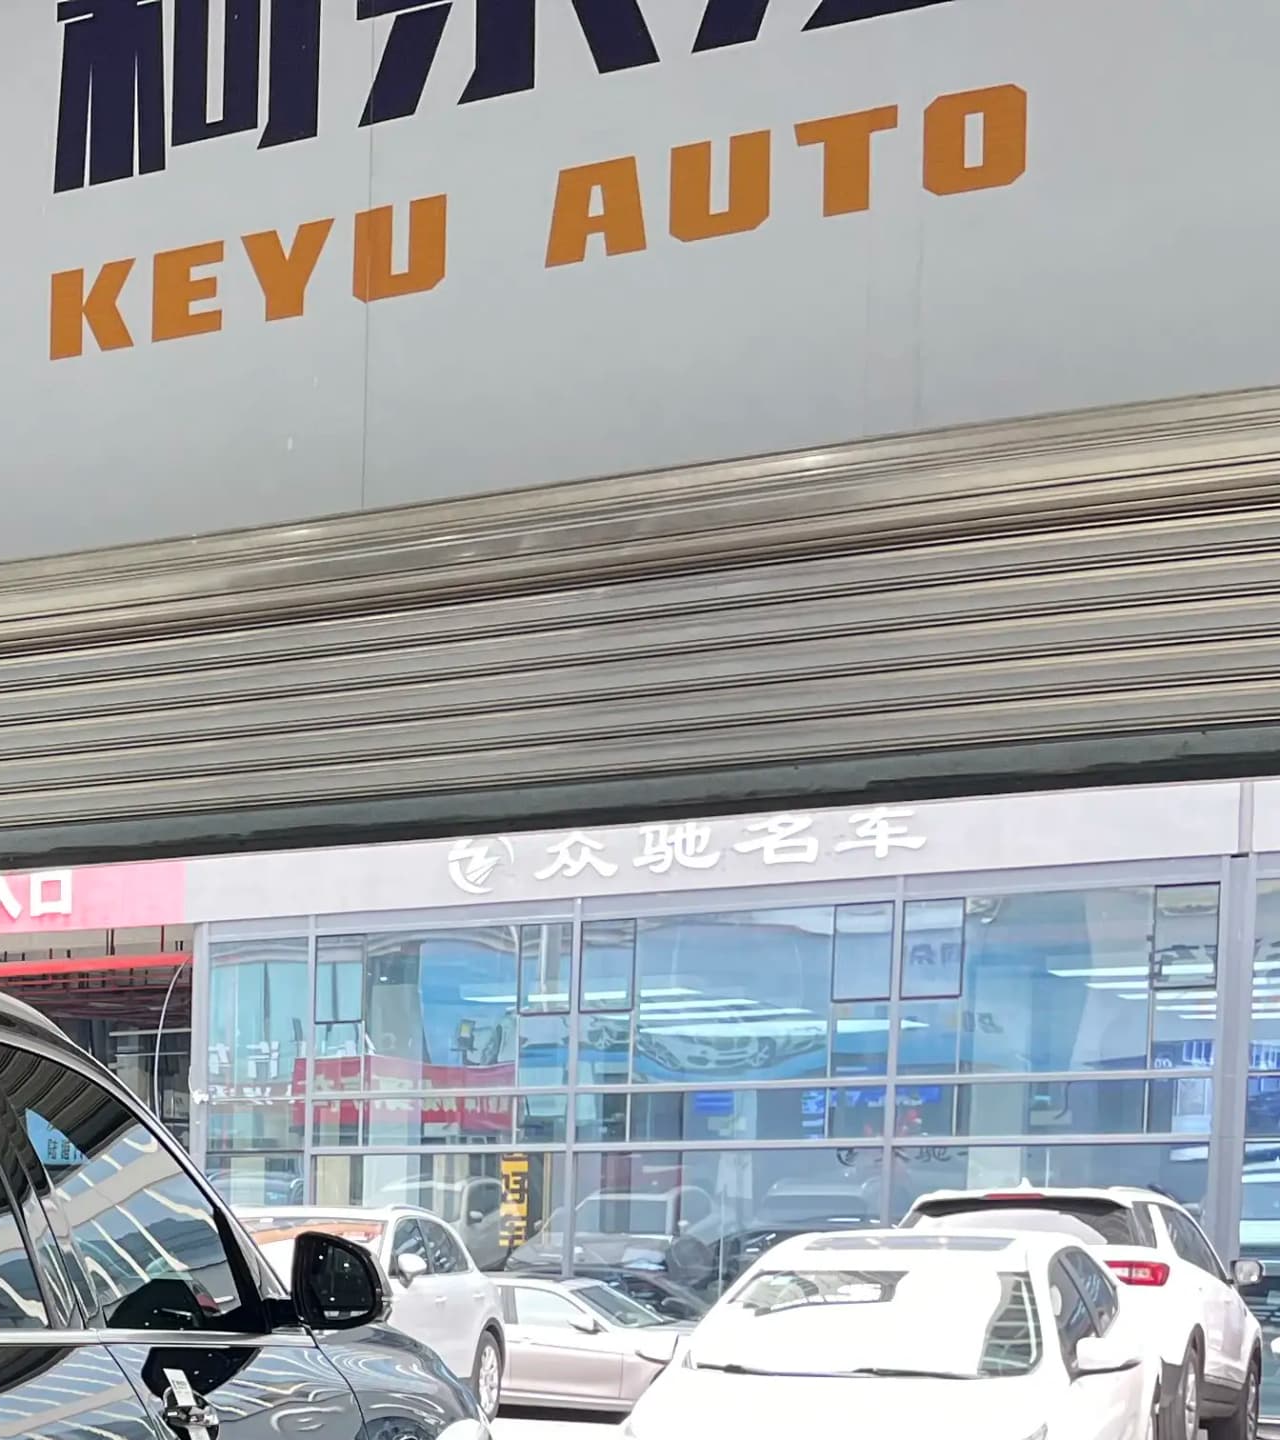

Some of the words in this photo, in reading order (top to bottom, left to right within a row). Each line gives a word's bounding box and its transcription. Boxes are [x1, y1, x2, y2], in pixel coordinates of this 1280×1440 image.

[49, 192, 447, 361] KEYU
[544, 83, 1027, 269] AUTO
[534, 806, 928, 880] 众驰名车
